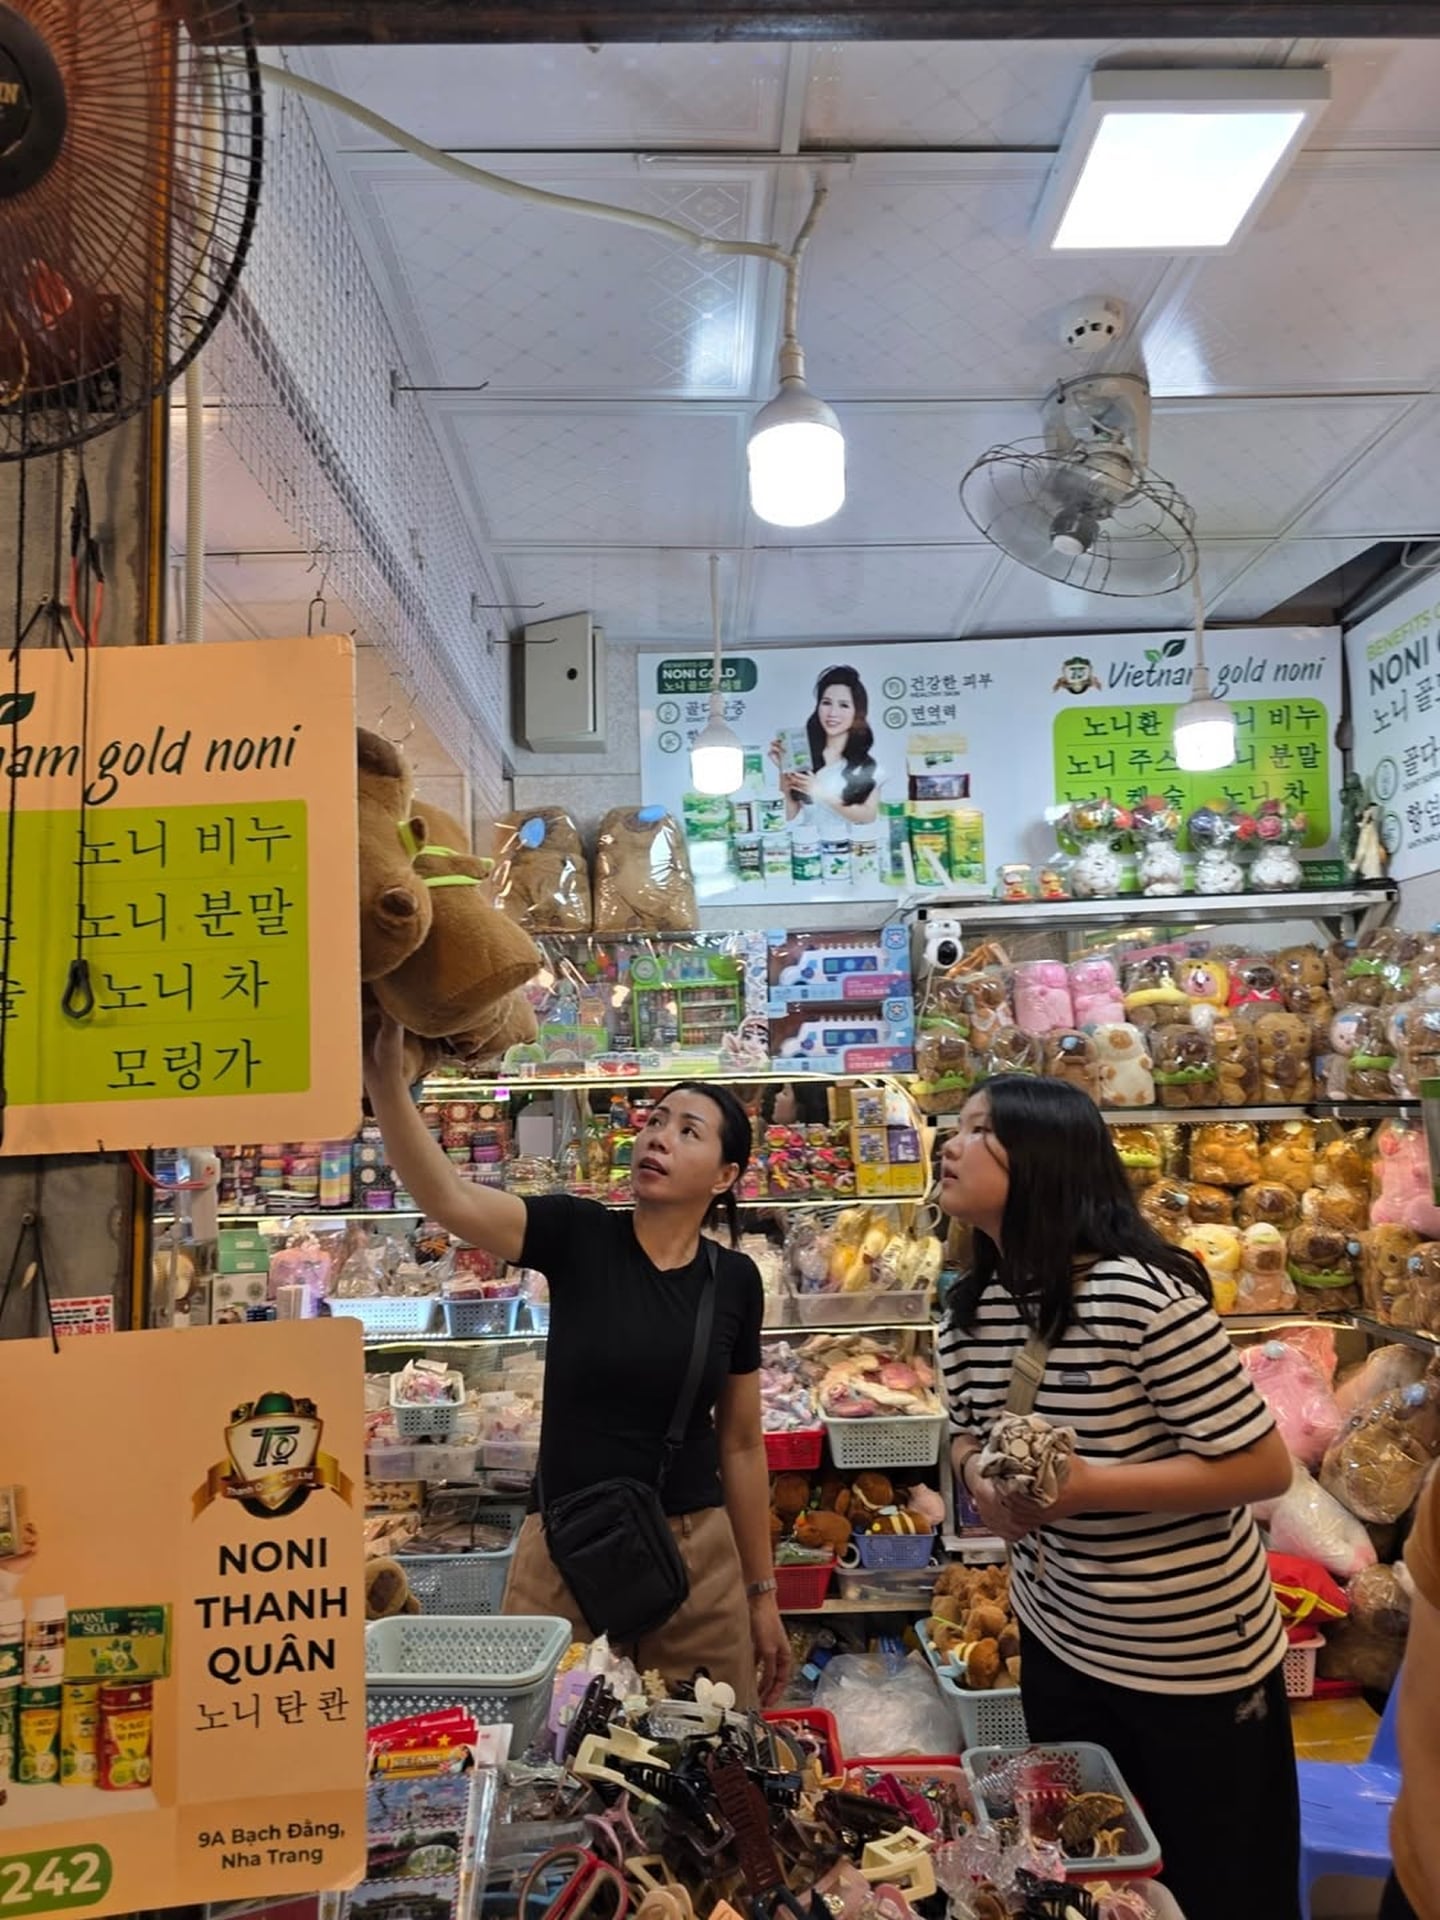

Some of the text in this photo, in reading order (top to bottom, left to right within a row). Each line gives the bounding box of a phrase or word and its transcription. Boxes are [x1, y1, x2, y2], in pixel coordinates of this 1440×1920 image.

[662, 668, 696, 680] NONI
[1211, 656, 1268, 700] gold
[1273, 657, 1327, 681] noni
[1369, 635, 1429, 696] NONI
[1268, 705, 1321, 732] 비누
[1372, 689, 1409, 734] 노니
[83, 726, 192, 805] gold
[205, 723, 302, 773] noni
[1066, 749, 1116, 776] 노니
[1268, 742, 1323, 769] 분말
[1282, 779, 1310, 806] 차
[73, 816, 293, 868] 노니 비누
[72, 892, 166, 942] 노니
[194, 886, 294, 938] 분말
[98, 962, 194, 1013] 노니
[220, 959, 270, 1010] 차
[106, 1037, 263, 1091] 모링가
[219, 1537, 327, 1576] NONI
[71, 1612, 105, 1625] NONI
[194, 1586, 348, 1629] THANH
[84, 1622, 119, 1635] SOAP
[207, 1633, 336, 1686] QUÂN
[195, 1692, 261, 1732] 노니
[198, 1831, 226, 1849] 9A
[232, 1825, 282, 1847] Bạch
[1, 1851, 102, 1905] 242
[221, 1847, 324, 1870] Nha Trang
